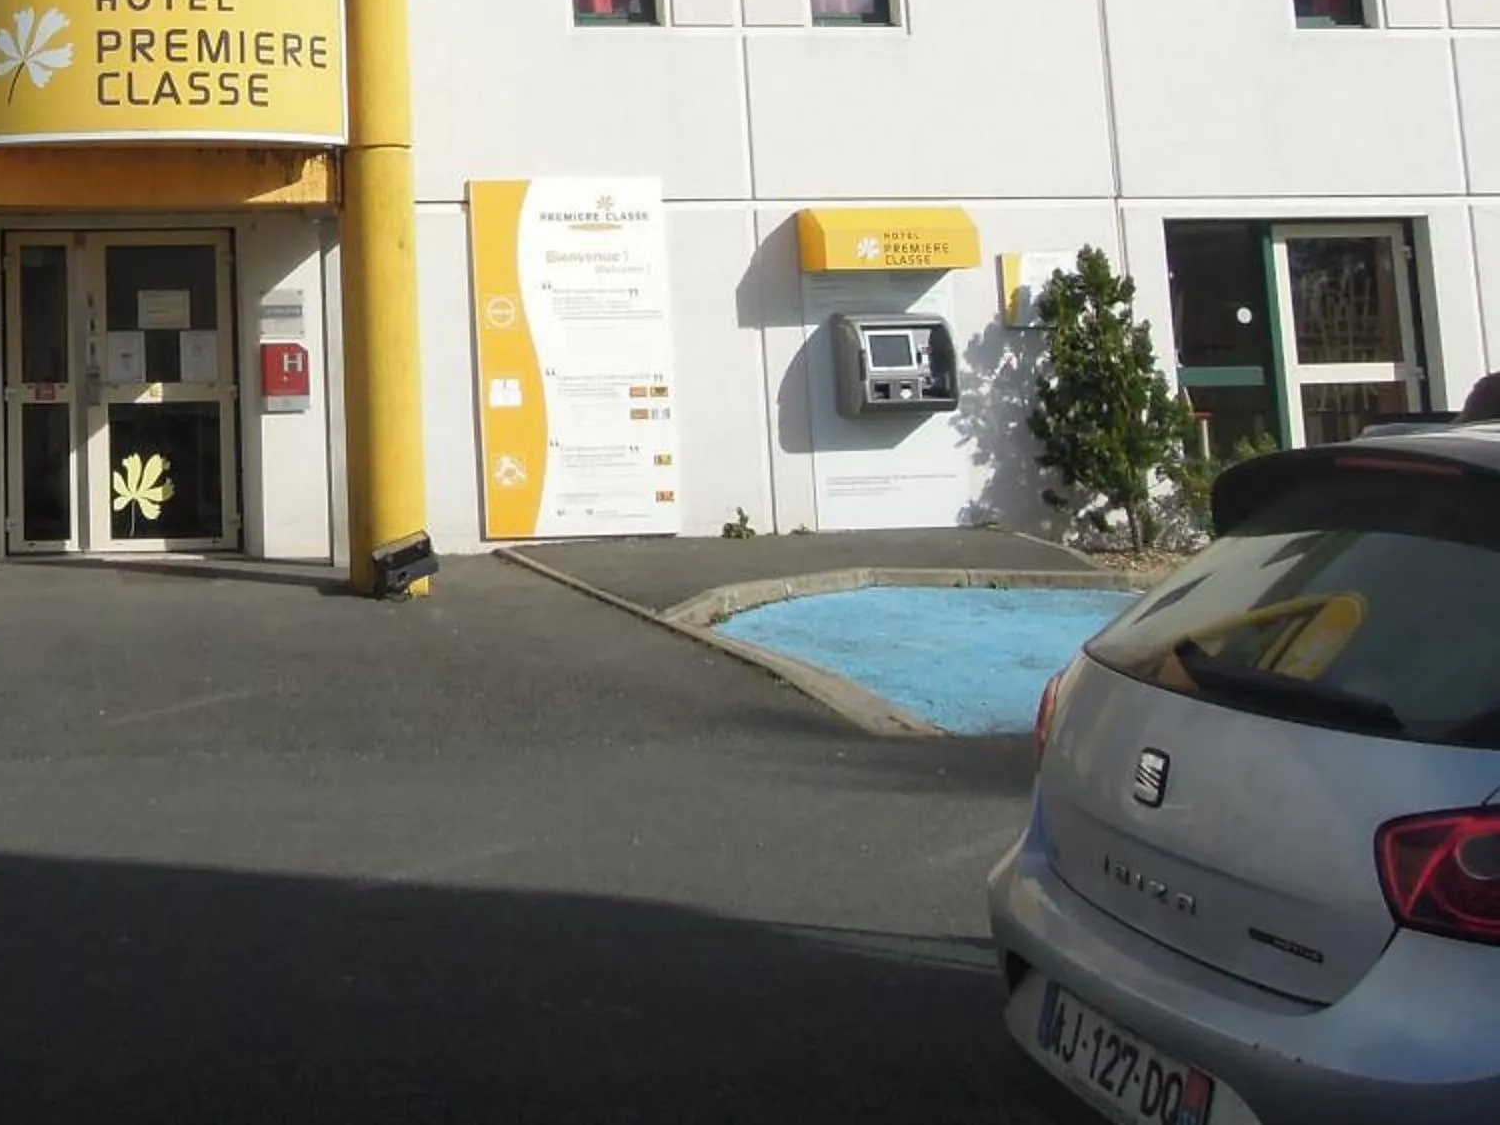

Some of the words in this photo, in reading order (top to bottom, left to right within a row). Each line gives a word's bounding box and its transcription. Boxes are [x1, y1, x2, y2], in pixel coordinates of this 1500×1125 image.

[96, 27, 328, 69] PREMIERE
[96, 71, 270, 107] CLASSE
[540, 211, 599, 222] PREMIERE
[883, 232, 920, 240] HOTEL
[883, 243, 949, 254] PREMIERE
[885, 254, 931, 265] CLASSE
[283, 353, 303, 373] H
